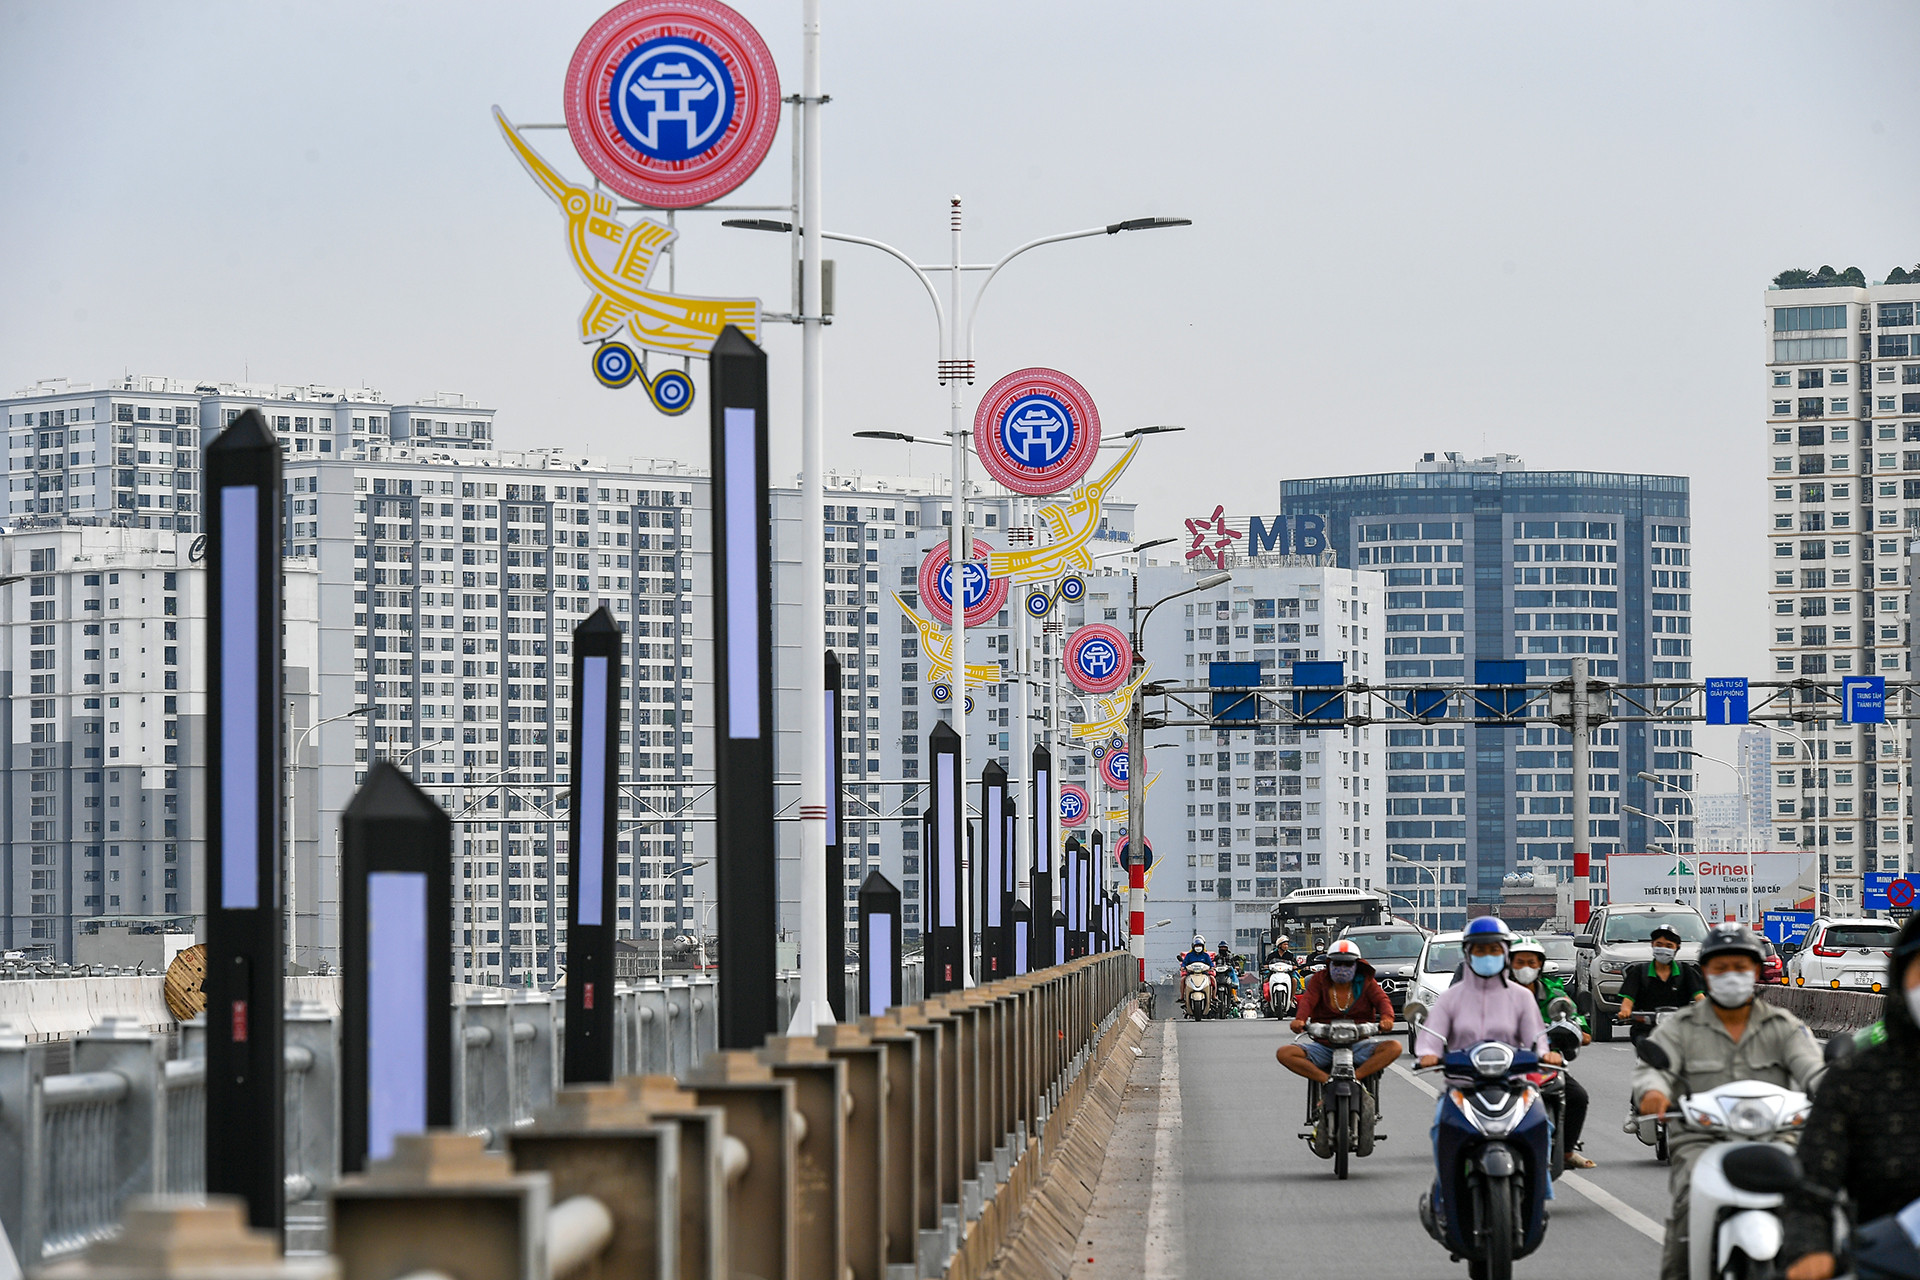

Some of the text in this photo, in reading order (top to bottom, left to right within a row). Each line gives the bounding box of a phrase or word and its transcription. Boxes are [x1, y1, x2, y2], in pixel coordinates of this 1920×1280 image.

[1249, 514, 1327, 557] MB
[1644, 885, 1661, 895] THIẾT
[1672, 885, 1687, 896] ĐỆN
[1717, 885, 1739, 894] THÔNG
[1740, 886, 1750, 894] GI
[1752, 886, 1766, 894] CAO
[1767, 883, 1781, 894] CẤP
